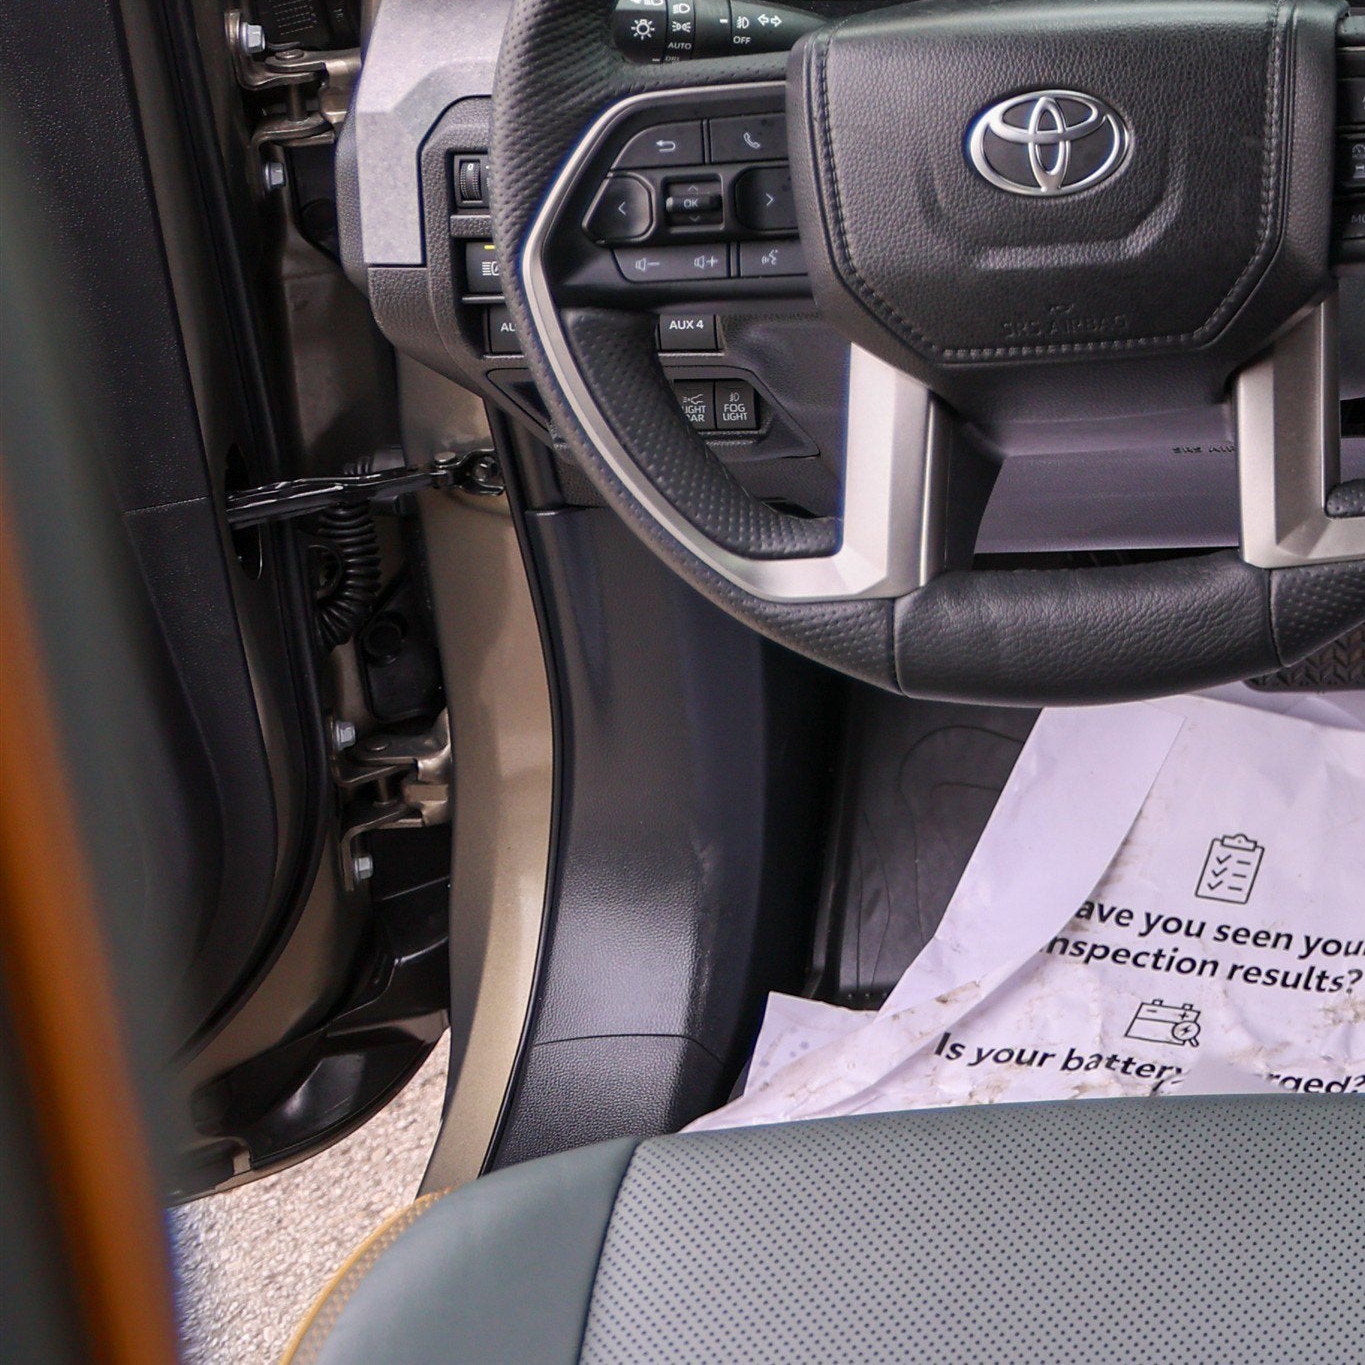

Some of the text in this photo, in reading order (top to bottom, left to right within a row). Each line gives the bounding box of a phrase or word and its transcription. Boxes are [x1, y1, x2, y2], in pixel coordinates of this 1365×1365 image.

[732, 36, 751, 45] OFF
[667, 41, 692, 51] AUTO
[683, 198, 699, 207] OK
[669, 319, 704, 330] AUX 4
[723, 403, 746, 413] FOG
[722, 412, 747, 422] LIGHT
[1137, 909, 1207, 938] you
[1212, 918, 1294, 950] seen
[1227, 960, 1364, 995] results?
[933, 1031, 1056, 1072] Is your
